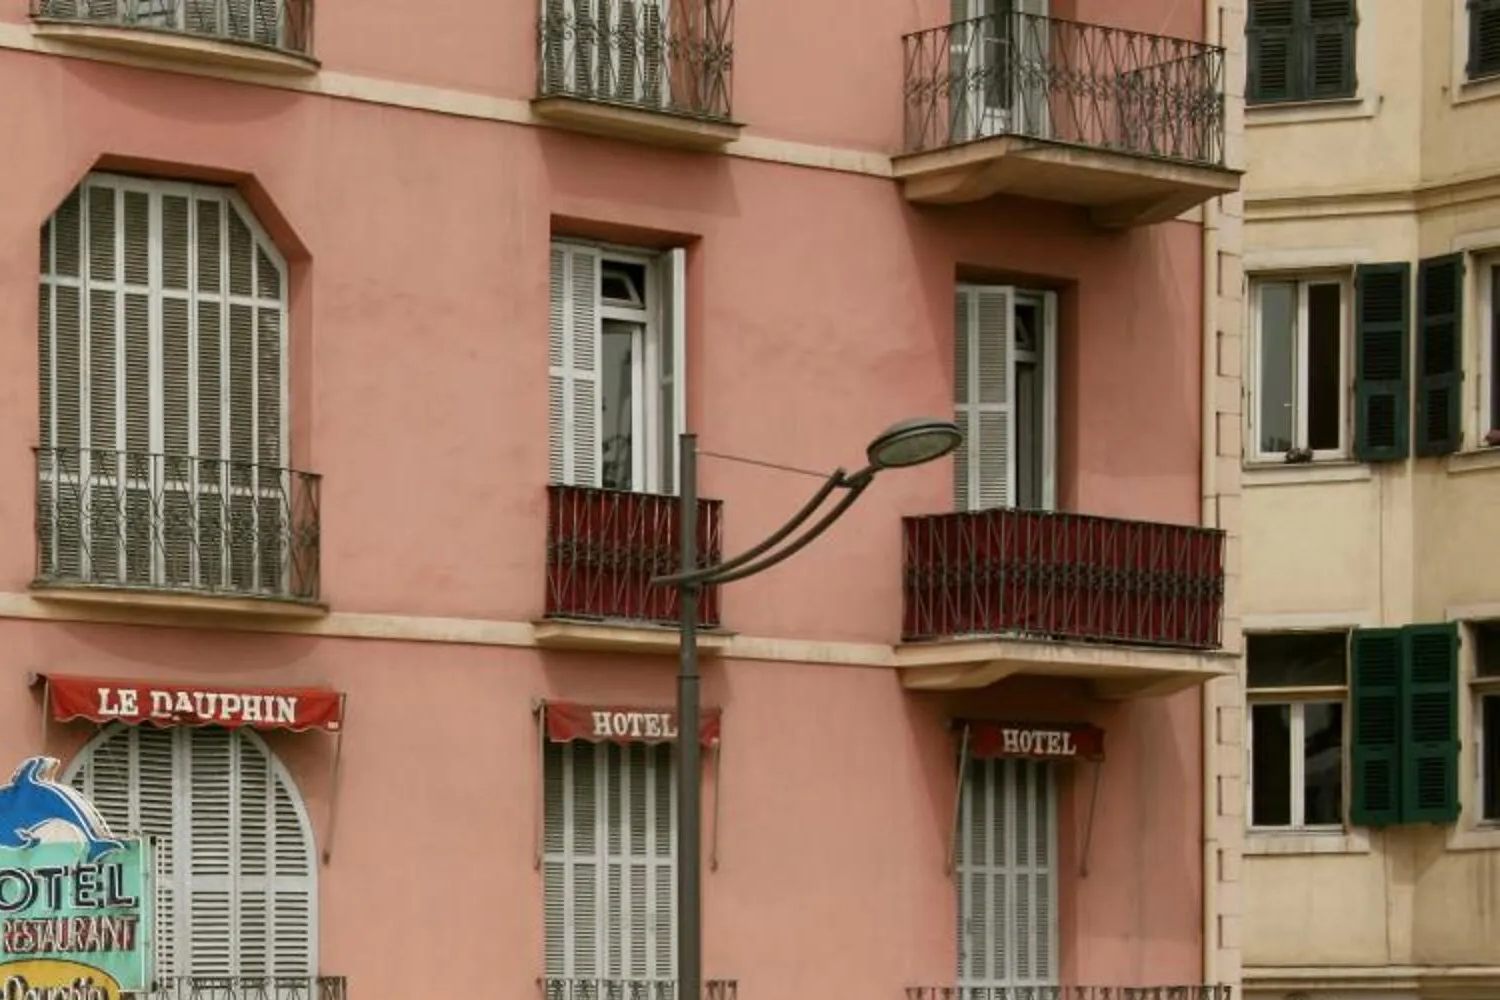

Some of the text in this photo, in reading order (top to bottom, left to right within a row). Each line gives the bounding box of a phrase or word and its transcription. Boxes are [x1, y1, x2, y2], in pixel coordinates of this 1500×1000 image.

[98, 687, 298, 723] LE DAUPHIN
[592, 711, 679, 738] HOTEL
[1002, 729, 1077, 755] HOTEL
[2, 914, 140, 954] RESTAURANT
